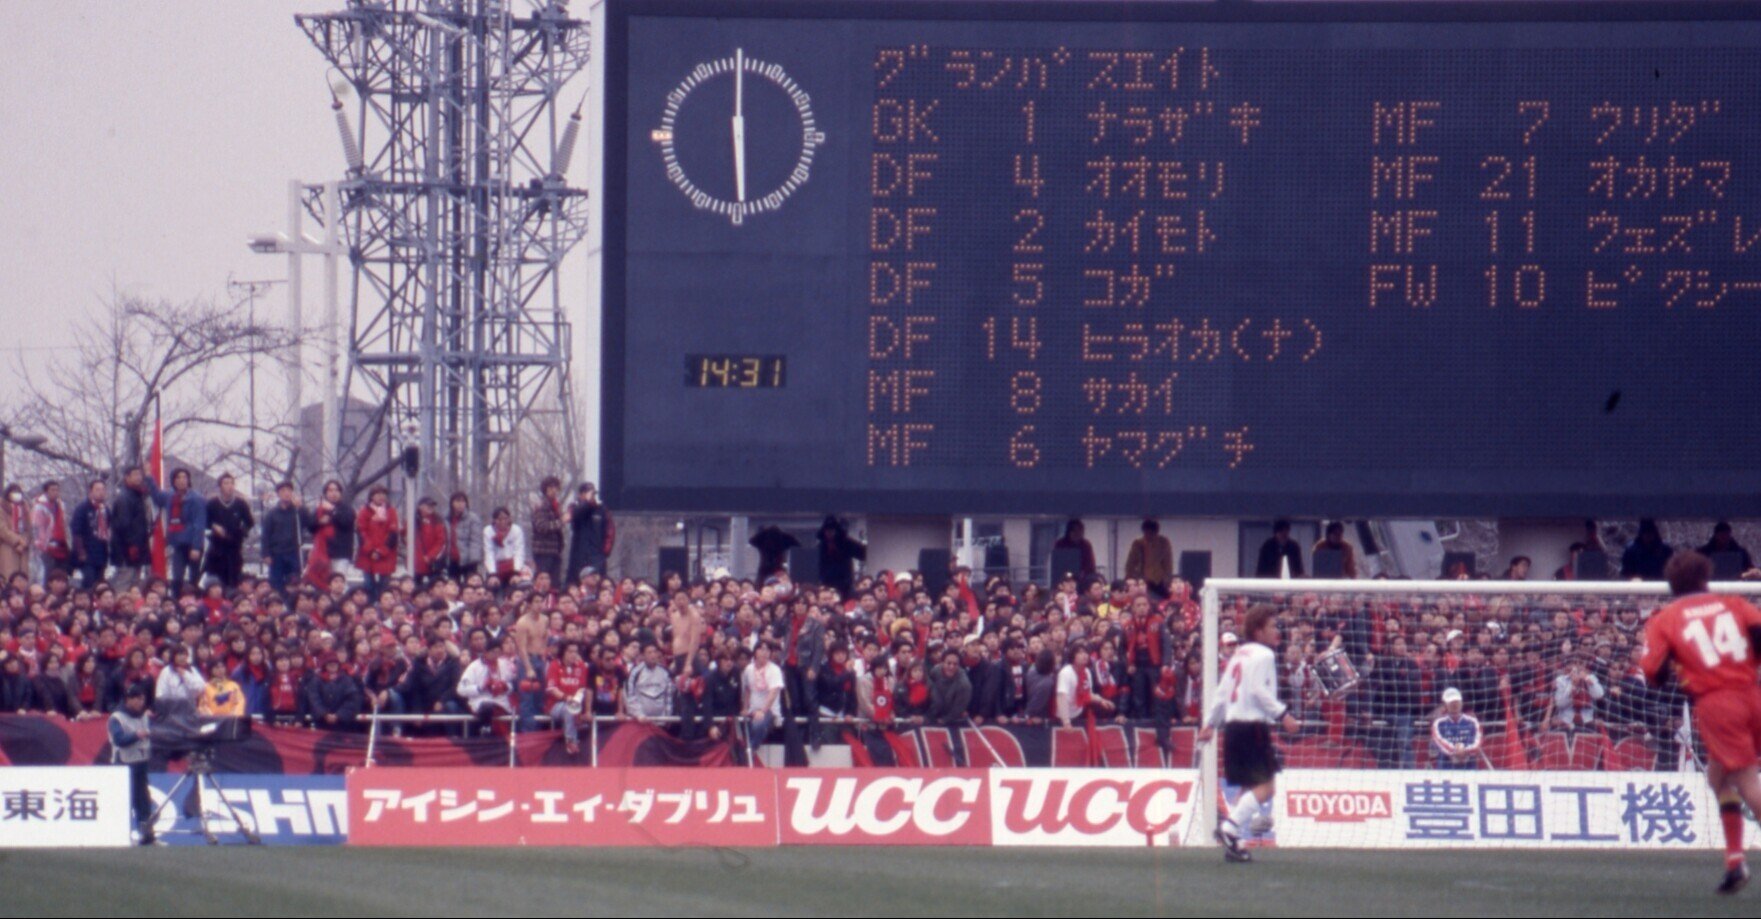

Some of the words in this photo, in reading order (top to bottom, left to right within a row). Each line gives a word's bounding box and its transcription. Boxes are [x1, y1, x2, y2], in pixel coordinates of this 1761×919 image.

[871, 97, 940, 142] GK
[1020, 100, 1035, 144] 1
[1372, 101, 1439, 146] MF
[1517, 99, 1551, 146] 7
[870, 152, 939, 197] DF
[1012, 153, 1045, 199] 4
[1086, 155, 1225, 200] オオモリ
[1370, 155, 1439, 199] MF
[1479, 154, 1536, 201] 21
[1588, 154, 1732, 200] オカヤマ
[869, 206, 936, 252] DF
[1012, 207, 1045, 254] 2
[1083, 208, 1216, 254] カイモト
[1369, 209, 1438, 253] MF
[1484, 209, 1536, 254] 11
[869, 260, 937, 305] DF
[1011, 262, 1044, 306] 5
[1369, 263, 1438, 307] FW
[1483, 263, 1546, 309] 10
[868, 314, 936, 360] DF
[981, 315, 1042, 360] 14
[700, 358, 781, 387] 14:31
[867, 369, 935, 412] MF
[1010, 370, 1042, 414] 8
[1081, 371, 1179, 415] サカイ
[867, 423, 935, 466] MF
[1009, 424, 1041, 469] 6
[1683, 611, 1748, 668] 14
[2, 788, 99, 821] 東海
[1290, 792, 1389, 816] TOYODA
[1403, 780, 1697, 845] 豊田工機
